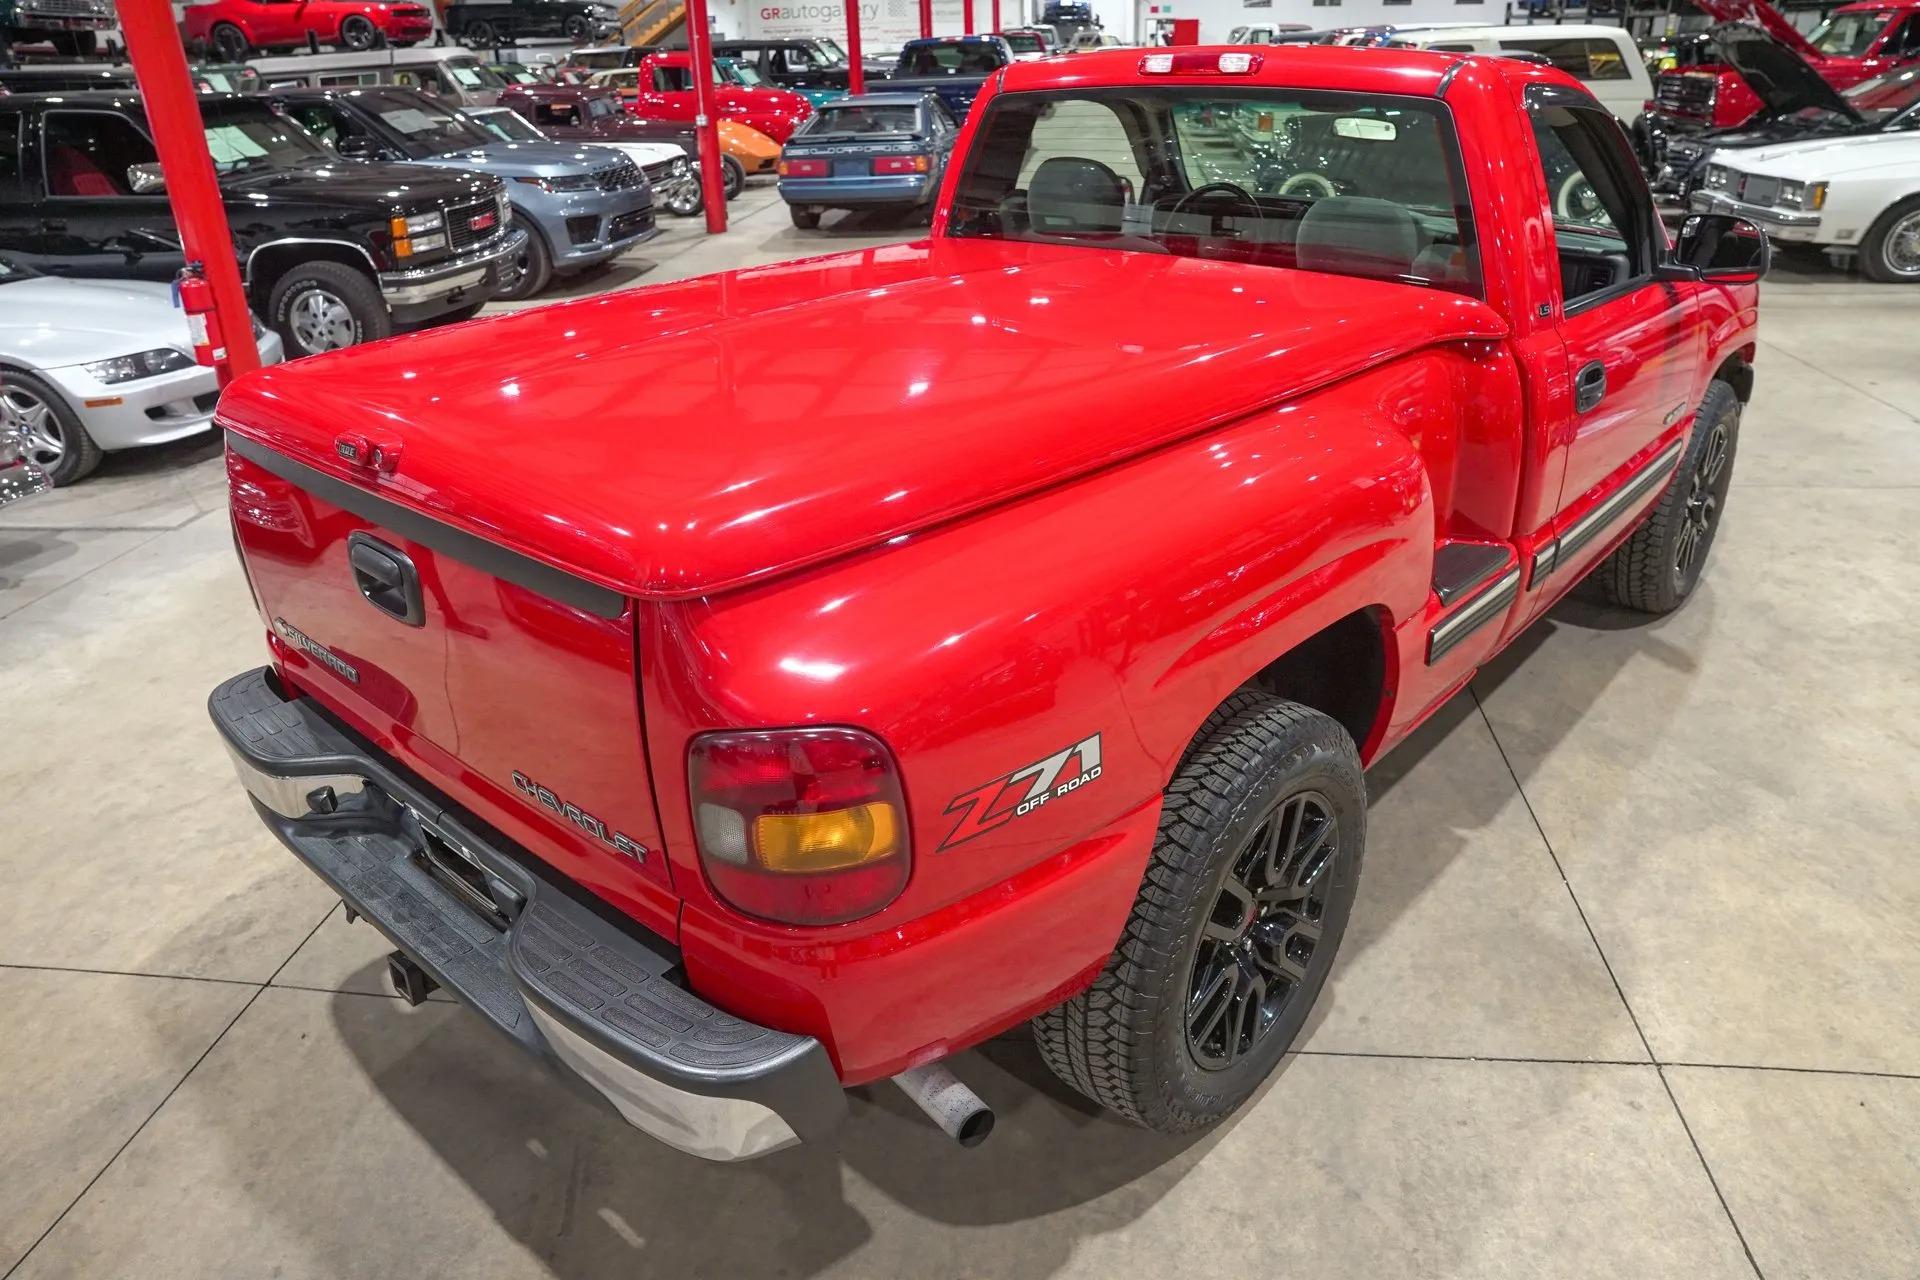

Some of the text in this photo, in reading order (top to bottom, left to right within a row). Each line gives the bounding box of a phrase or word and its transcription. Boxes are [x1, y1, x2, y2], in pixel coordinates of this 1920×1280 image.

[287, 627, 360, 684] SILVERADO
[511, 769, 648, 864] CHEVROLET
[933, 731, 1102, 854] Z71
[1016, 766, 1102, 816] OFF ROAD
